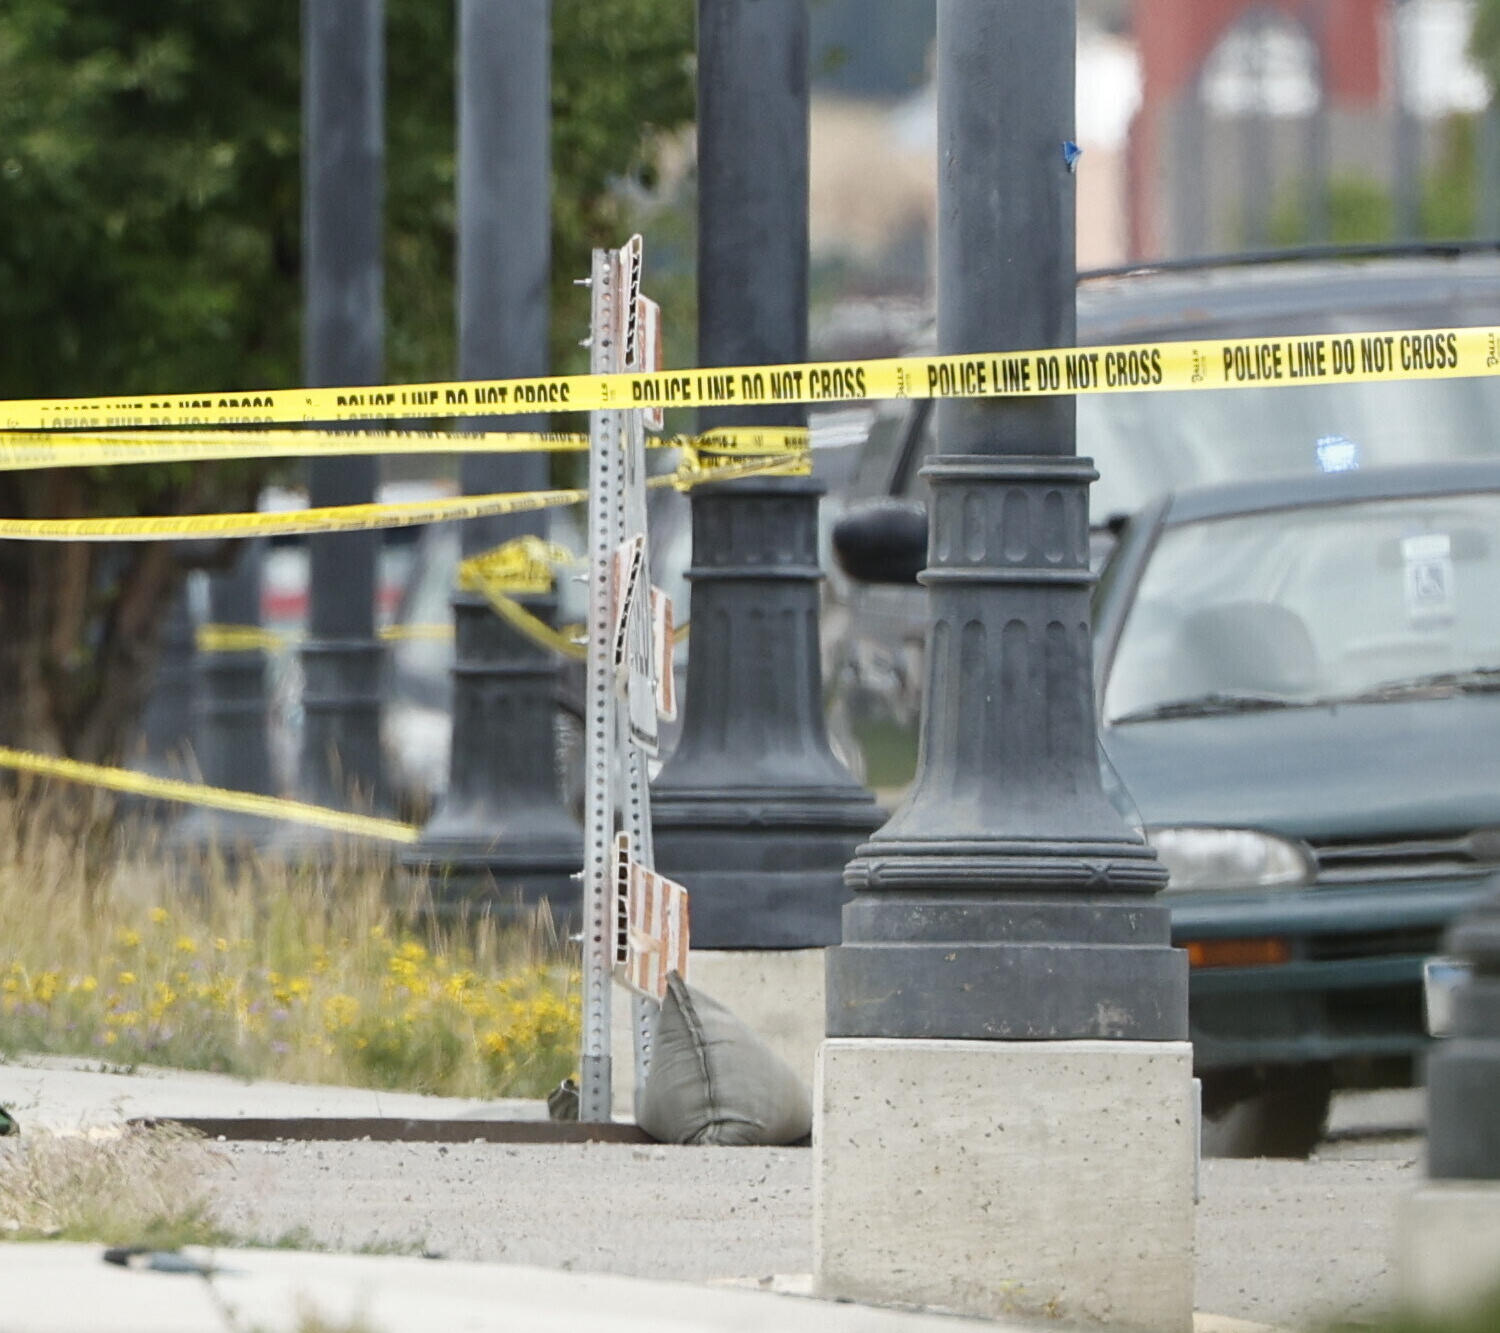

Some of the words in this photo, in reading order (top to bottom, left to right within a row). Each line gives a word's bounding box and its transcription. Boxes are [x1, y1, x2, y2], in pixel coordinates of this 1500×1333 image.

[927, 361, 986, 397] POLICE
[992, 358, 1030, 393] LINE
[1037, 356, 1060, 391] DO
[1066, 353, 1099, 389] NOT
[1105, 349, 1162, 386] CROSS
[1223, 343, 1282, 381] POLICE
[1288, 340, 1326, 377] LINE
[1332, 338, 1354, 375] DO
[1361, 336, 1394, 373] NOT
[1400, 333, 1458, 371] CROSS
[770, 370, 802, 399] NOT
[809, 367, 866, 398] CROSS
